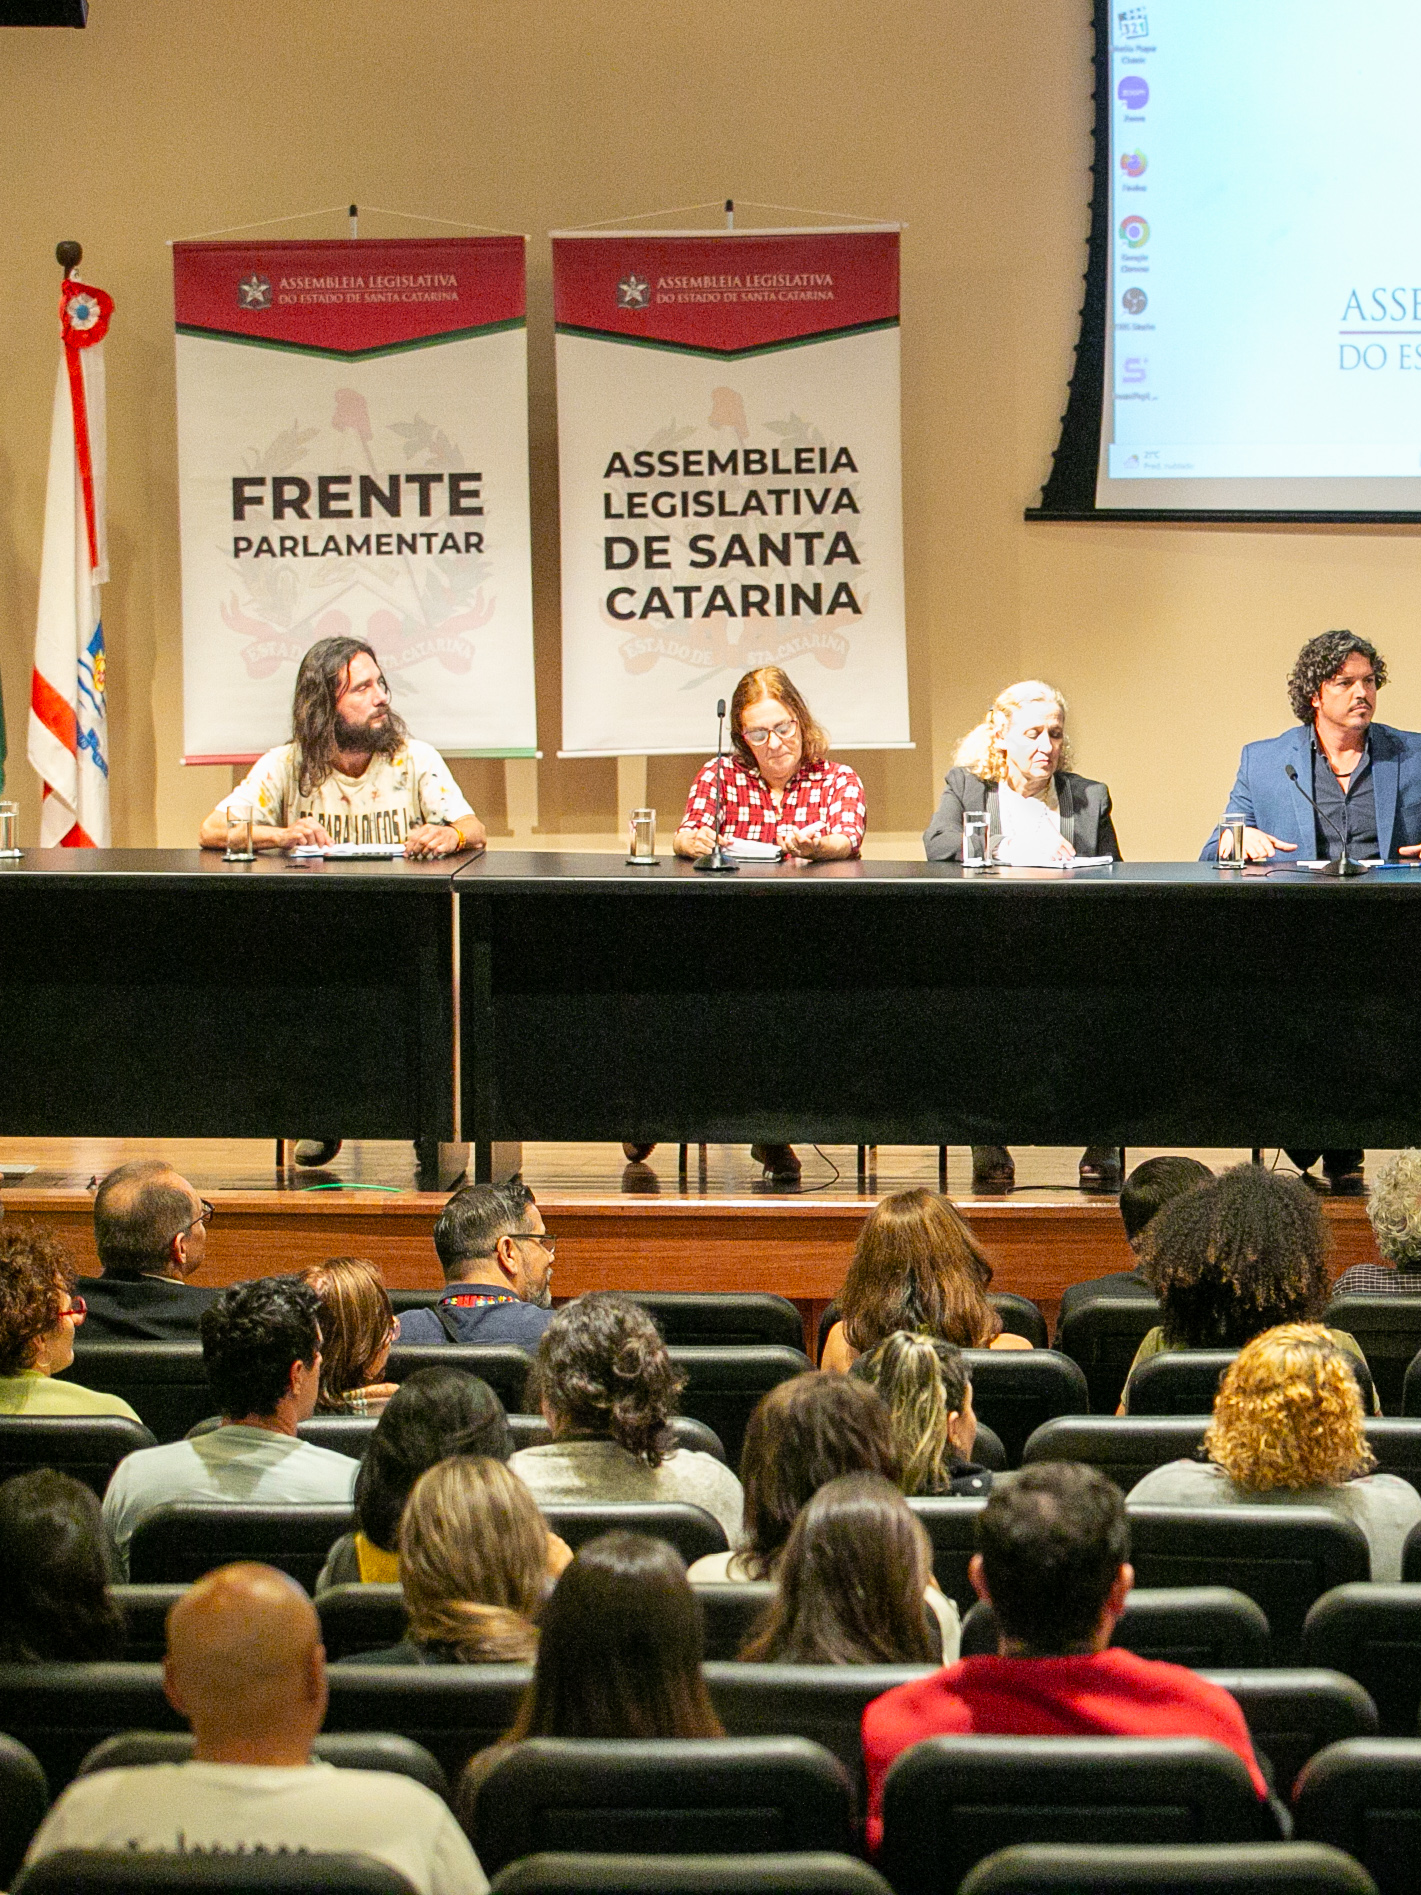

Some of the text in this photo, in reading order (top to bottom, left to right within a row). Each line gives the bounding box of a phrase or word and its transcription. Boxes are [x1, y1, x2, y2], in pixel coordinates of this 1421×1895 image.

[279, 274, 458, 290] ASSEMBLEIA LEGISLATIVA
[657, 273, 834, 290] ASSEMBLEIA LEGISLATIVA
[279, 291, 459, 305] DO ESTADO DE SANTA CATARINA
[656, 290, 835, 305] DO ESTADO DE SANTA CATARINA
[1339, 343, 1387, 371] DO
[603, 446, 859, 479] ASSEMBLEIA
[232, 472, 485, 522] FRENTE
[603, 487, 861, 520] LEGISLATIVA
[233, 531, 485, 559] PARLAMENTAR
[604, 531, 861, 571] DE SANTA
[605, 582, 863, 621] CATARINA
[246, 640, 304, 663] ESTAD
[402, 637, 472, 662] CATARINA
[623, 637, 714, 665] ESTADO DE
[777, 634, 847, 658] CATARINA
